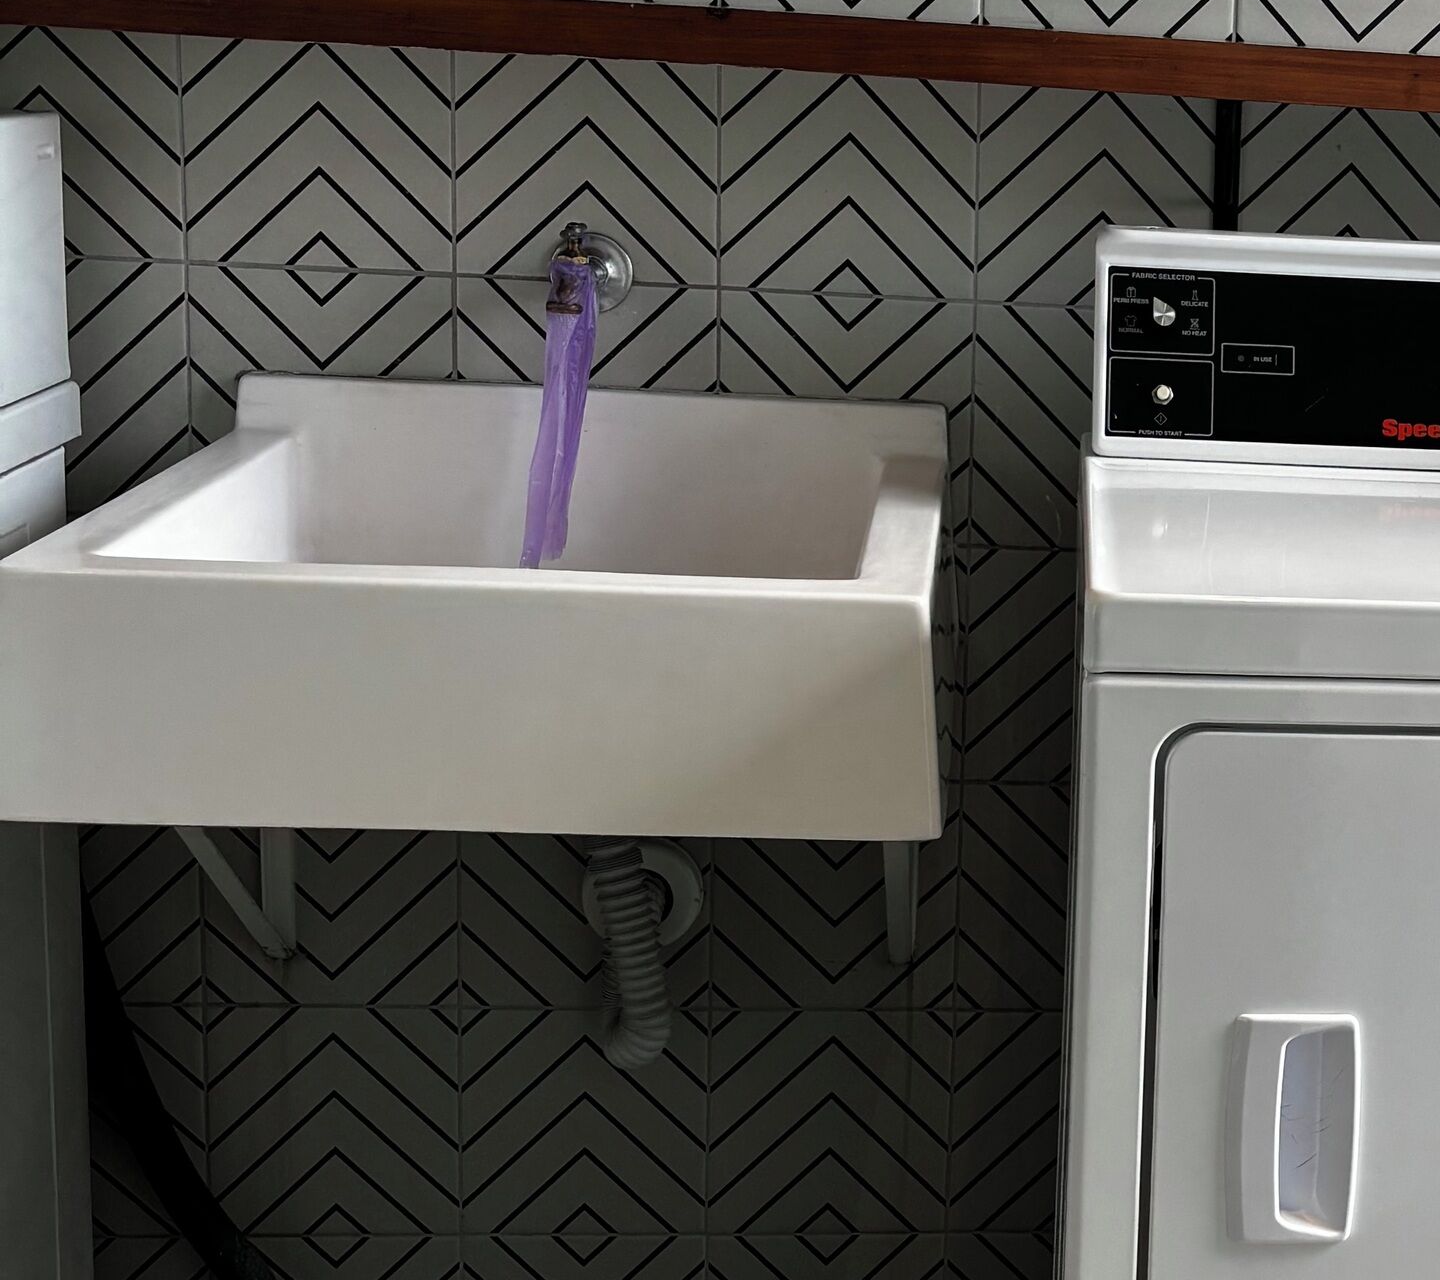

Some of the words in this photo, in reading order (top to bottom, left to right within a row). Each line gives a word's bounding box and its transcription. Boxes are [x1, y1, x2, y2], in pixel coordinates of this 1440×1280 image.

[1131, 272, 1157, 280] FABRIC
[1159, 273, 1196, 281] SELECTOR
[1180, 300, 1209, 308] DELICATE
